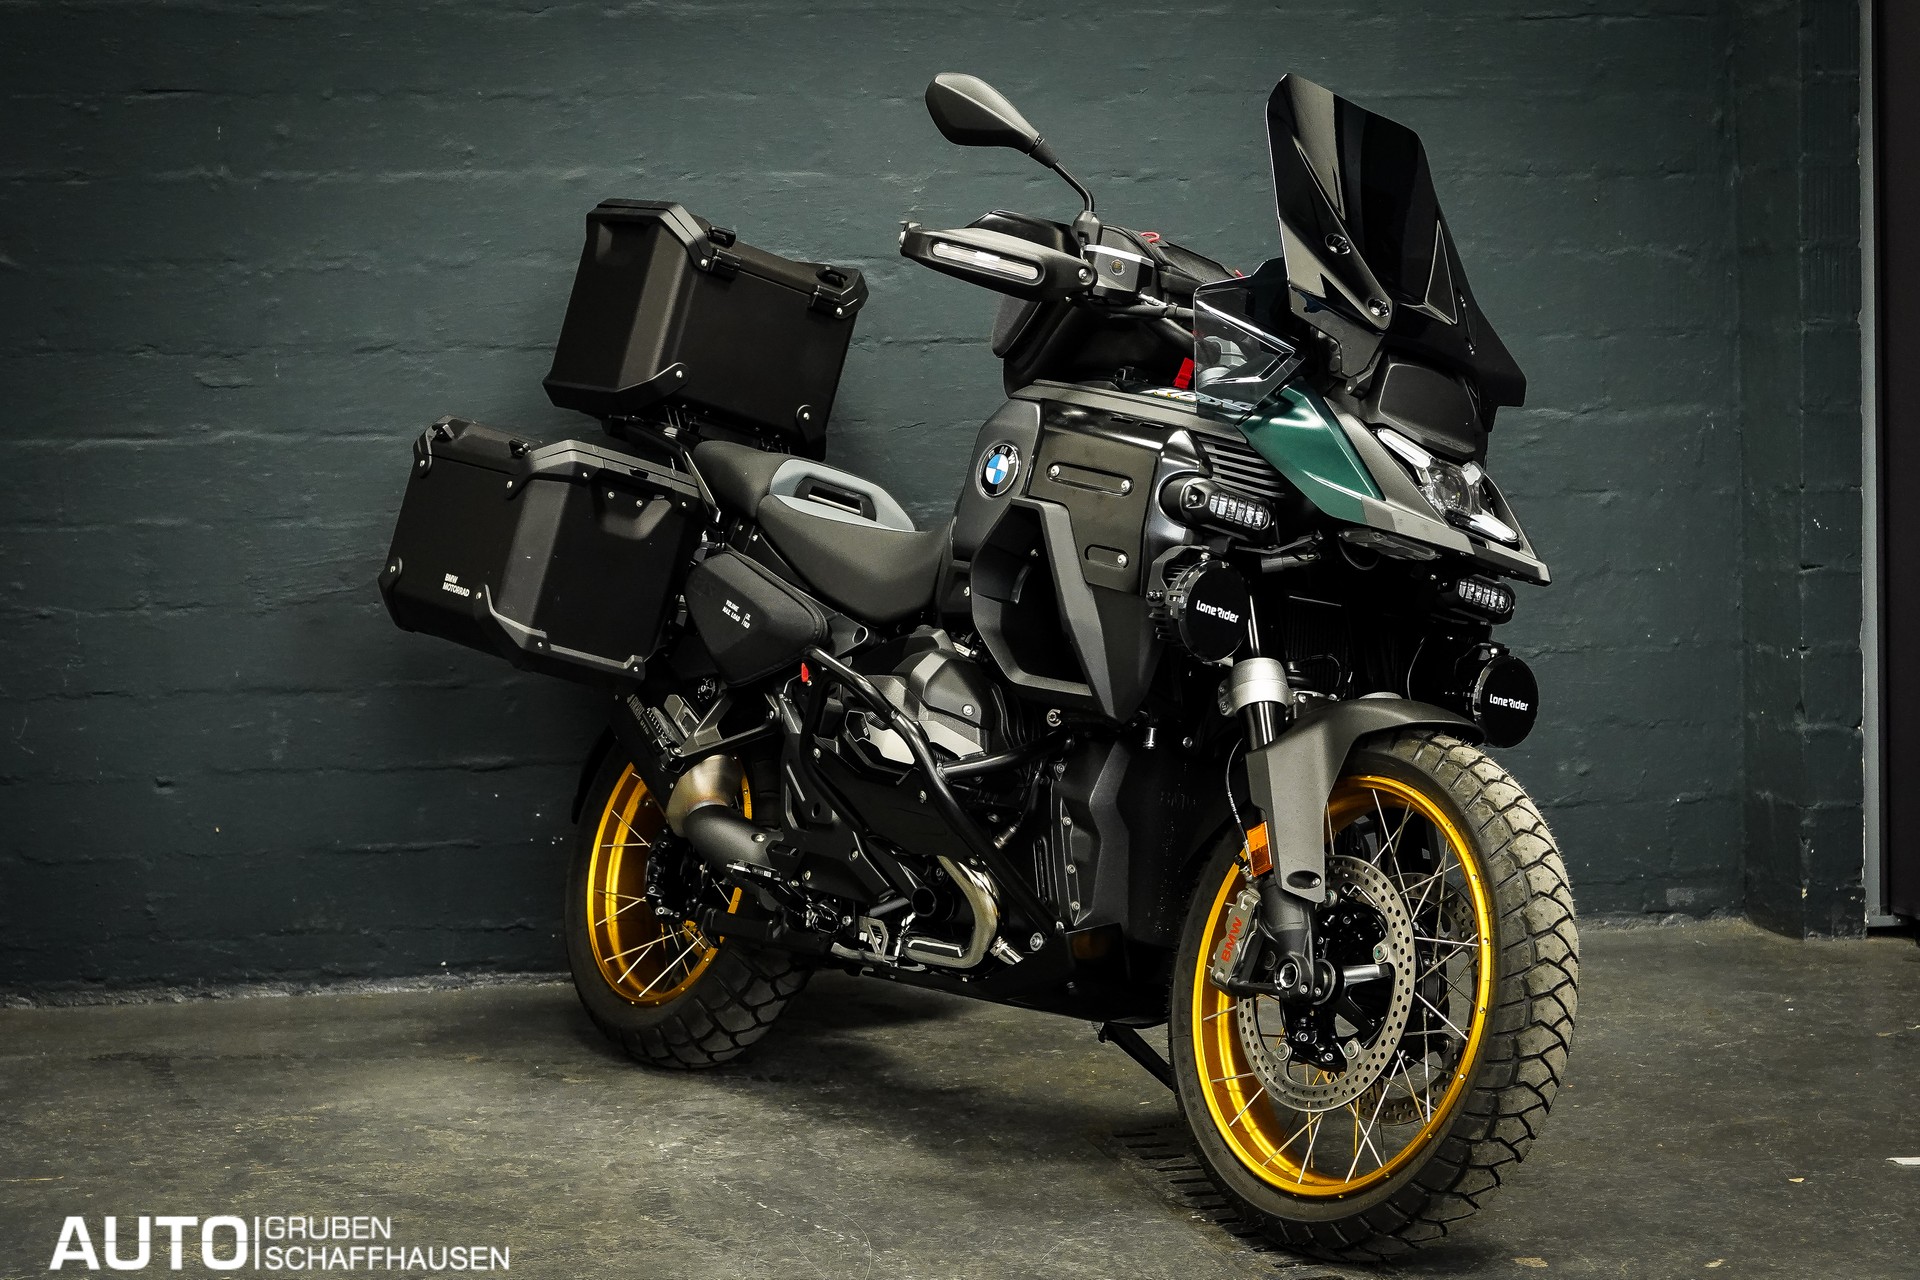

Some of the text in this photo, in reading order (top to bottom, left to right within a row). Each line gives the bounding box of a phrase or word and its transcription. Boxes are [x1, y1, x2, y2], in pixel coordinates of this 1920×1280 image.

[988, 445, 1016, 465] BMW
[442, 581, 470, 597] MOTORRAD
[1196, 599, 1239, 623] Lone Rider
[1489, 693, 1529, 711] Lone Rider
[1221, 916, 1243, 963] BMW
